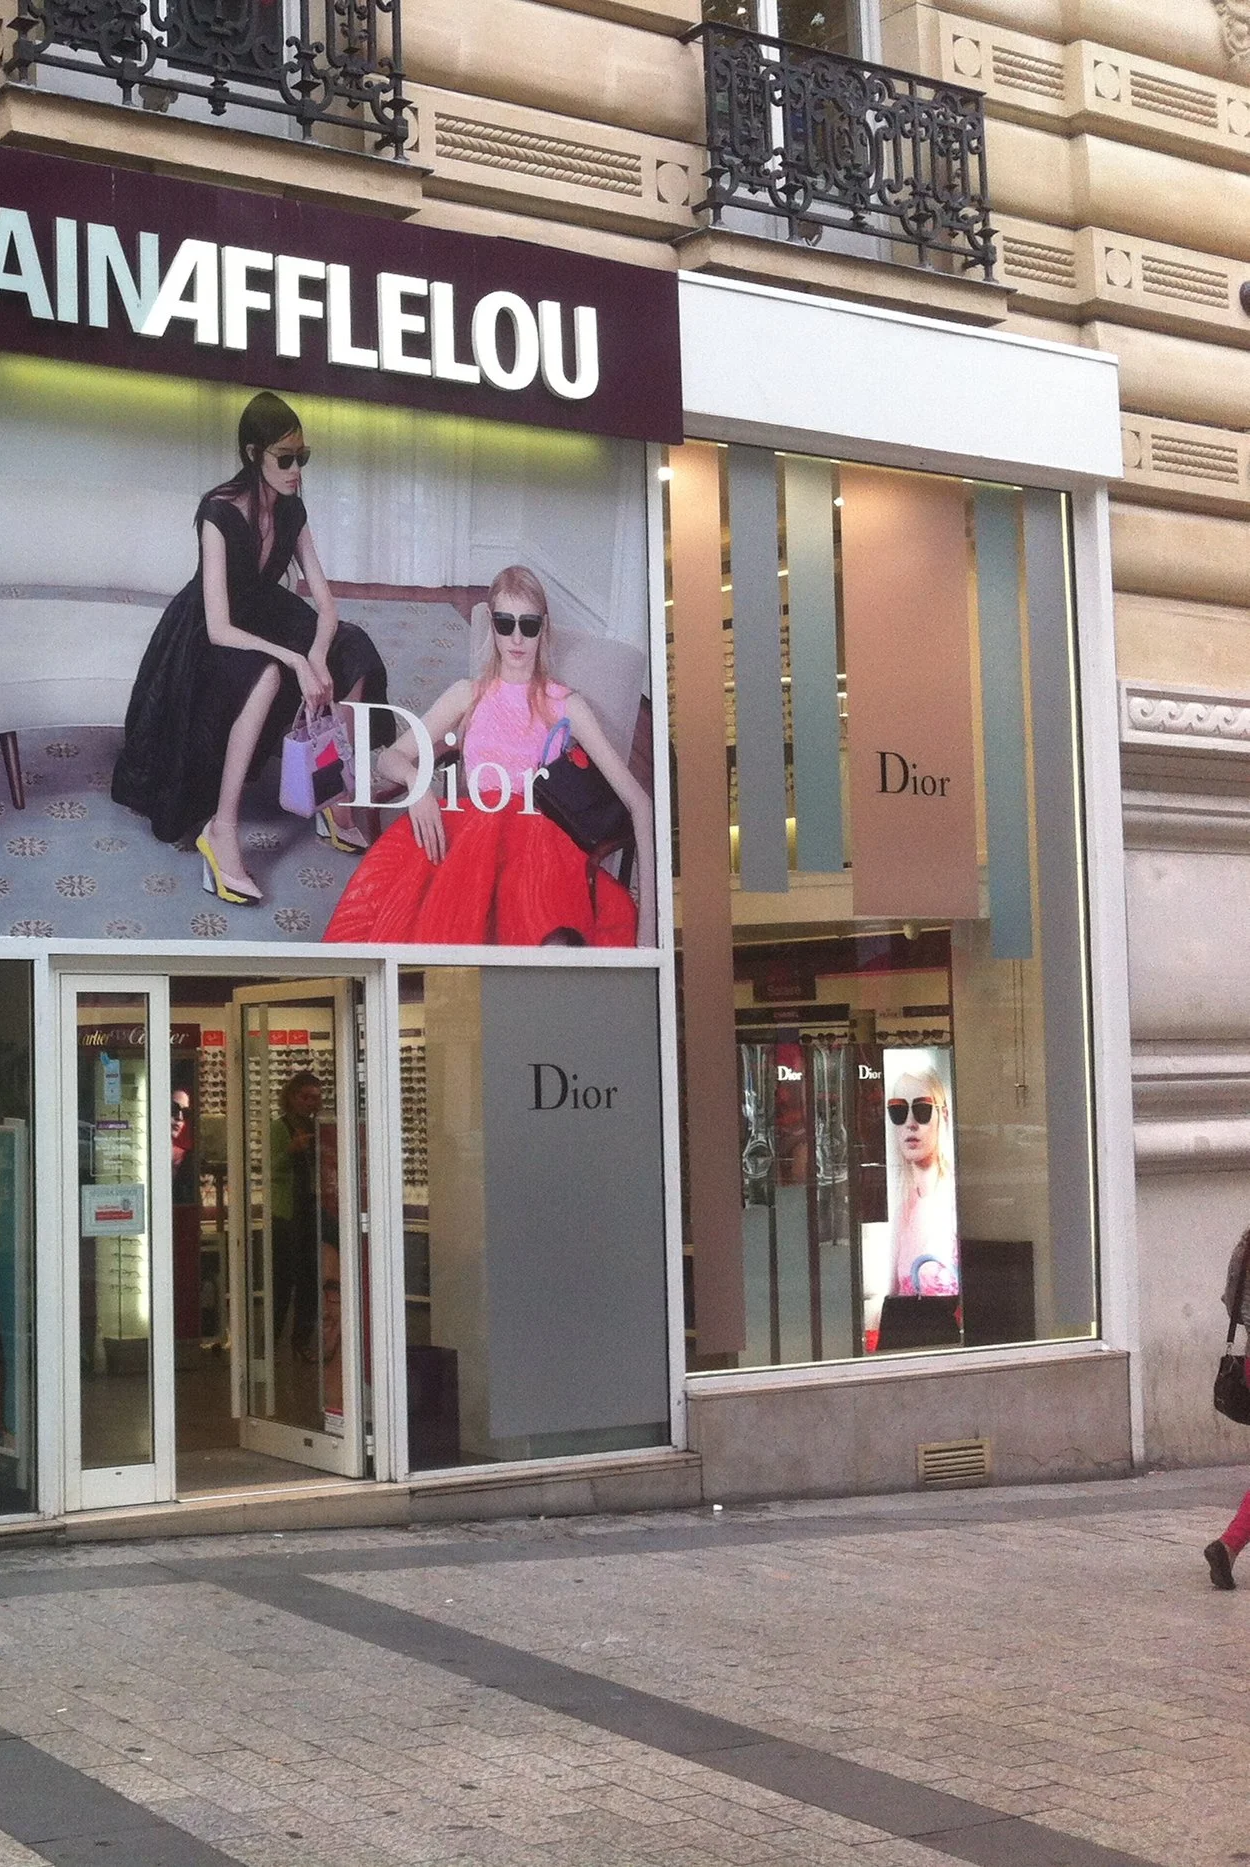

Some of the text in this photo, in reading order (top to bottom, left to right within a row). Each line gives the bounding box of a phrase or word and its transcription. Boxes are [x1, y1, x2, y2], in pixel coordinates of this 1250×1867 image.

[338, 701, 550, 816] Dior
[874, 751, 951, 797] Dior
[527, 1063, 618, 1111] Dior
[777, 1065, 803, 1081] Dior
[858, 1064, 882, 1080] Dior
